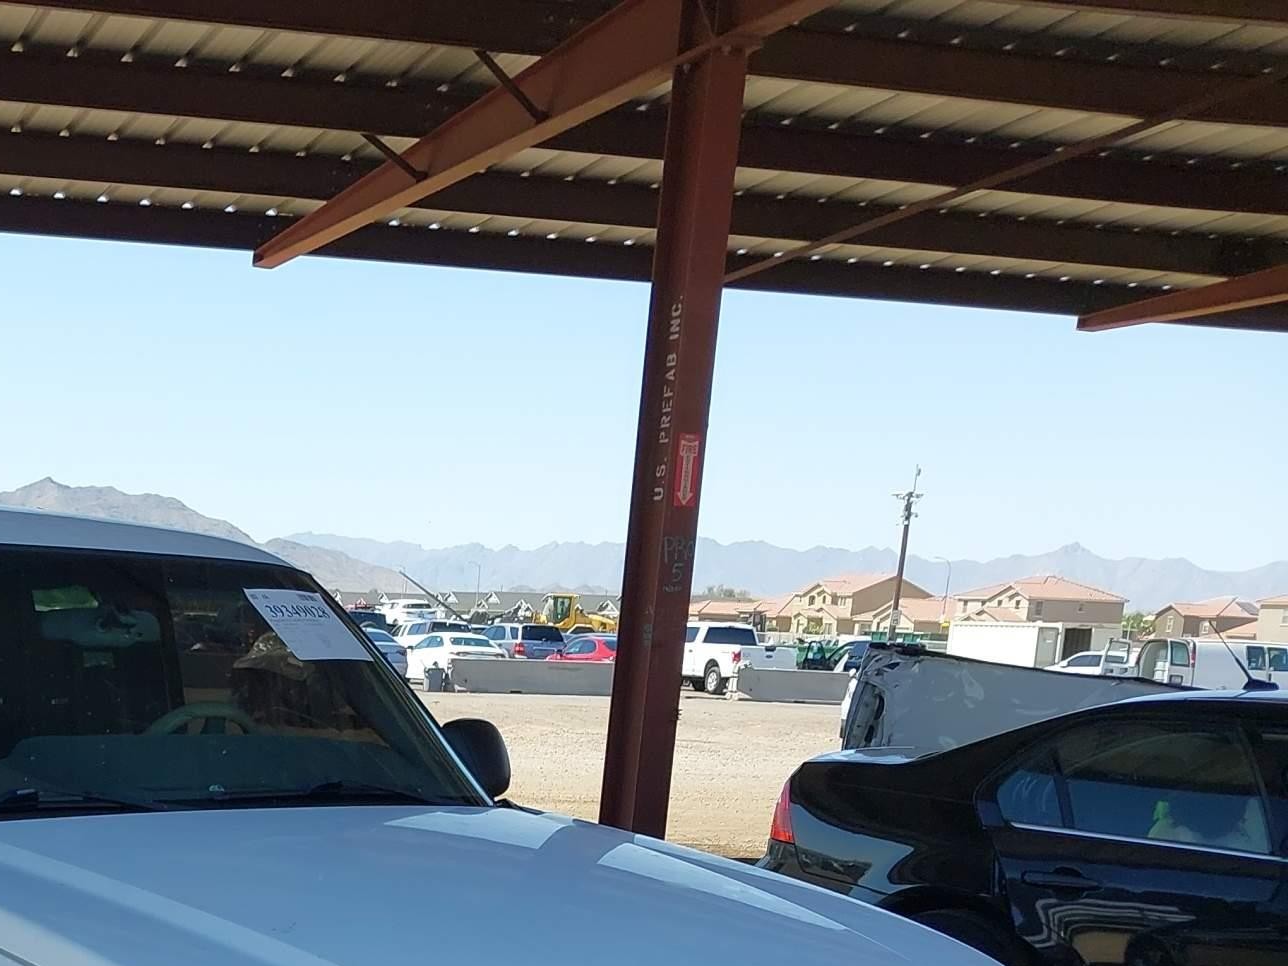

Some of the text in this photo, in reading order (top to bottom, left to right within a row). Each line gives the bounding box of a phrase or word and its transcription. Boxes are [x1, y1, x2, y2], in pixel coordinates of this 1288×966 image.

[653, 295, 684, 501] U.S. PREFAB INC.
[671, 562, 685, 583] 5
[266, 605, 330, 618] 39349028
